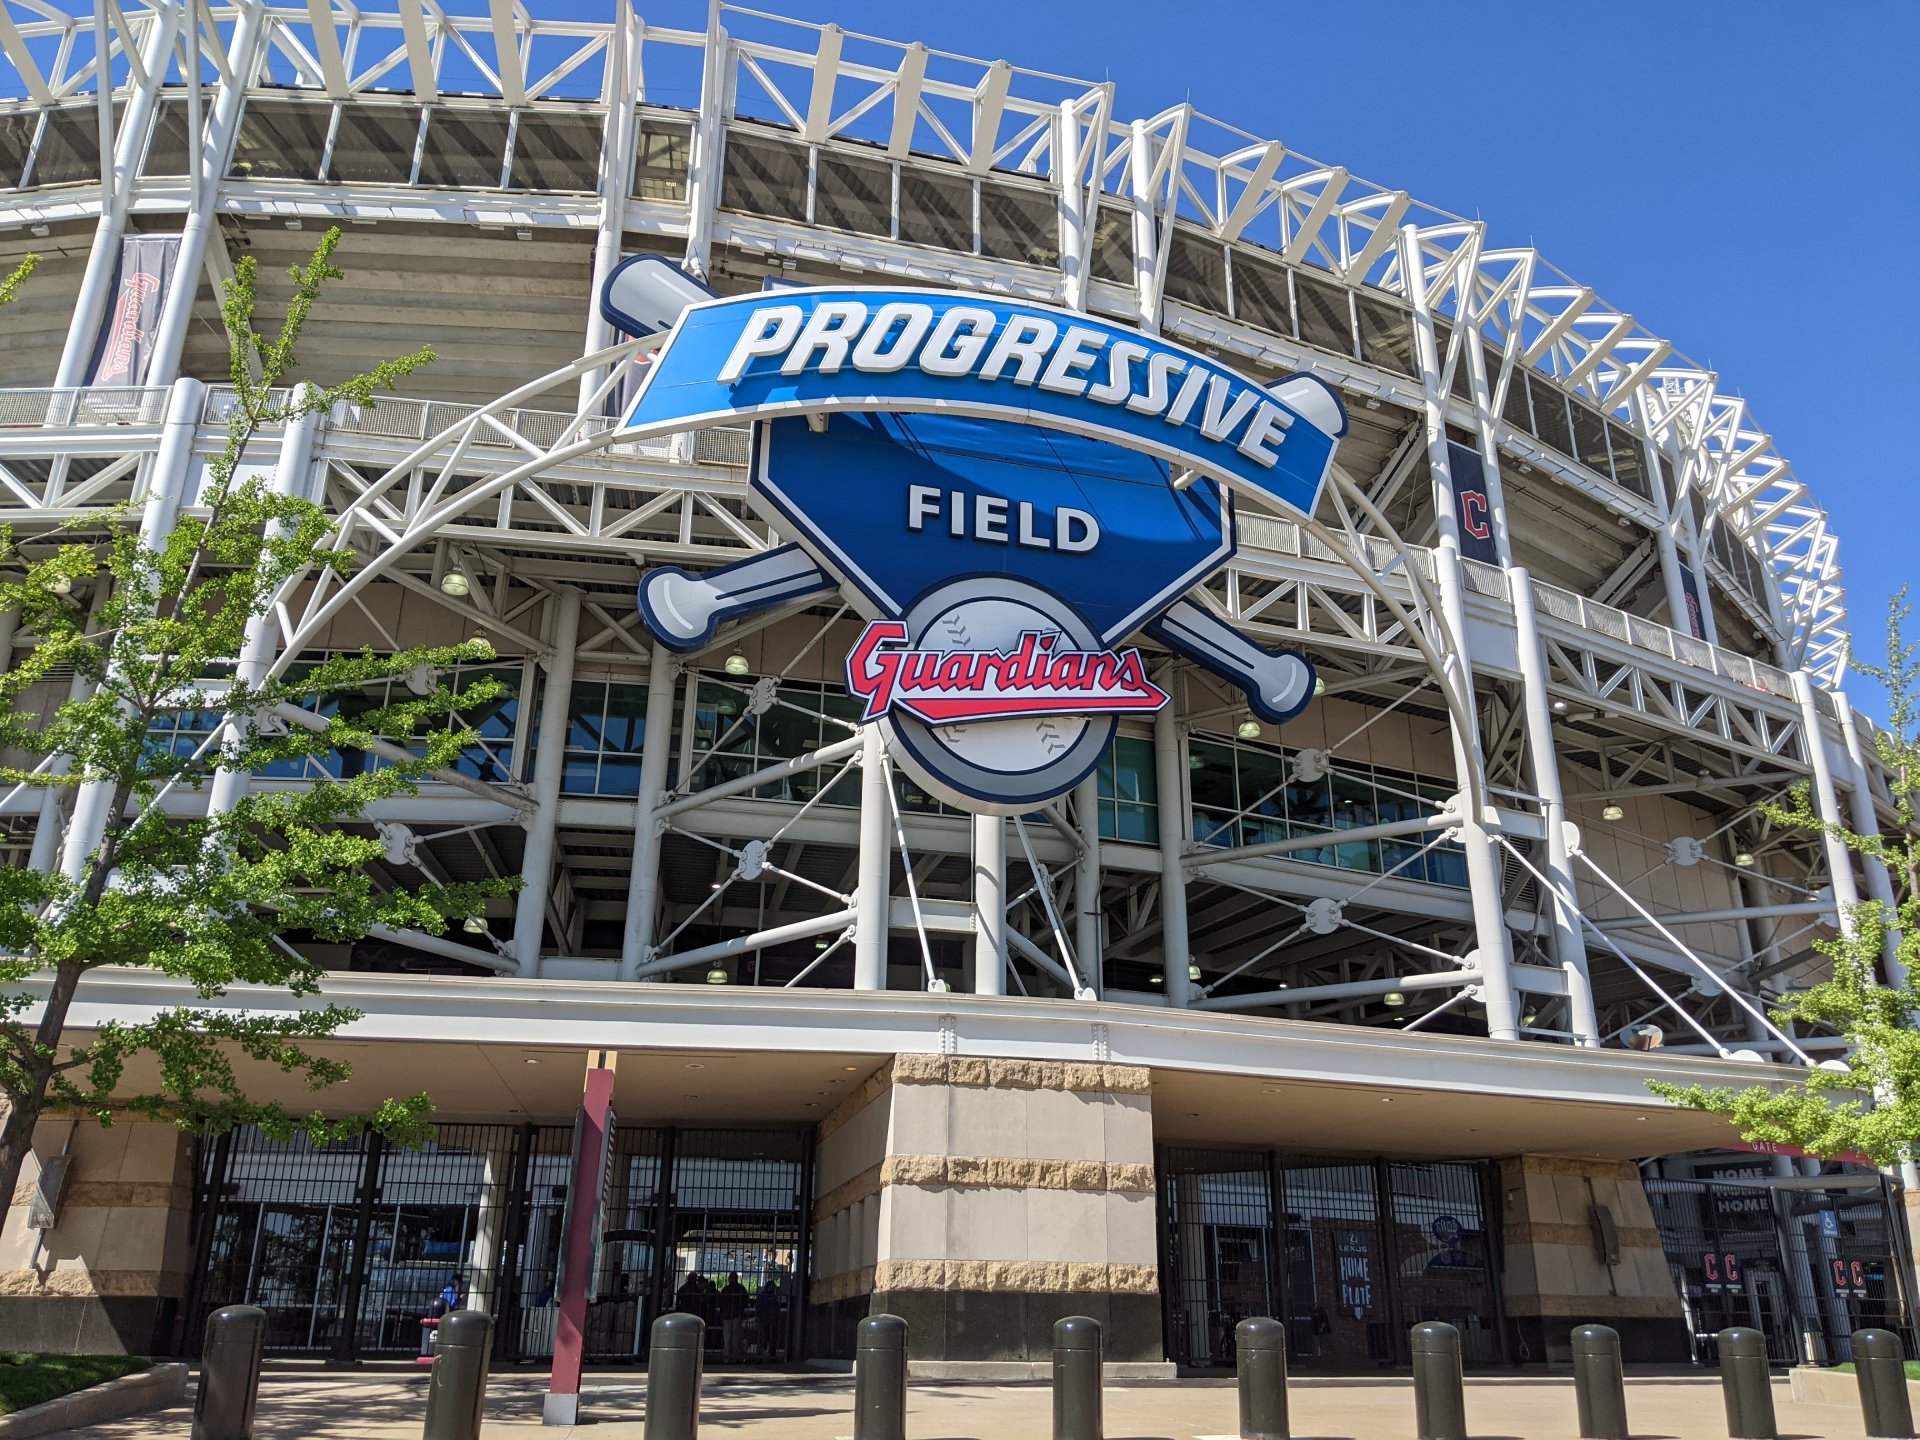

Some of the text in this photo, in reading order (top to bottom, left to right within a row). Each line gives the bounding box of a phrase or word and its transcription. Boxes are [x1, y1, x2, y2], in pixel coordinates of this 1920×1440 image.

[102, 272, 160, 382] Guardians
[716, 301, 1296, 468] PROGRESSIVE
[907, 485, 1100, 555] FIELD
[1460, 490, 1490, 539] C
[846, 620, 1168, 724] Guardians
[1752, 1142, 1778, 1153] GATE
[1718, 1198, 1769, 1212] HOME
[1340, 1257, 1370, 1281] HOME
[1342, 1285, 1372, 1308] PLATE
